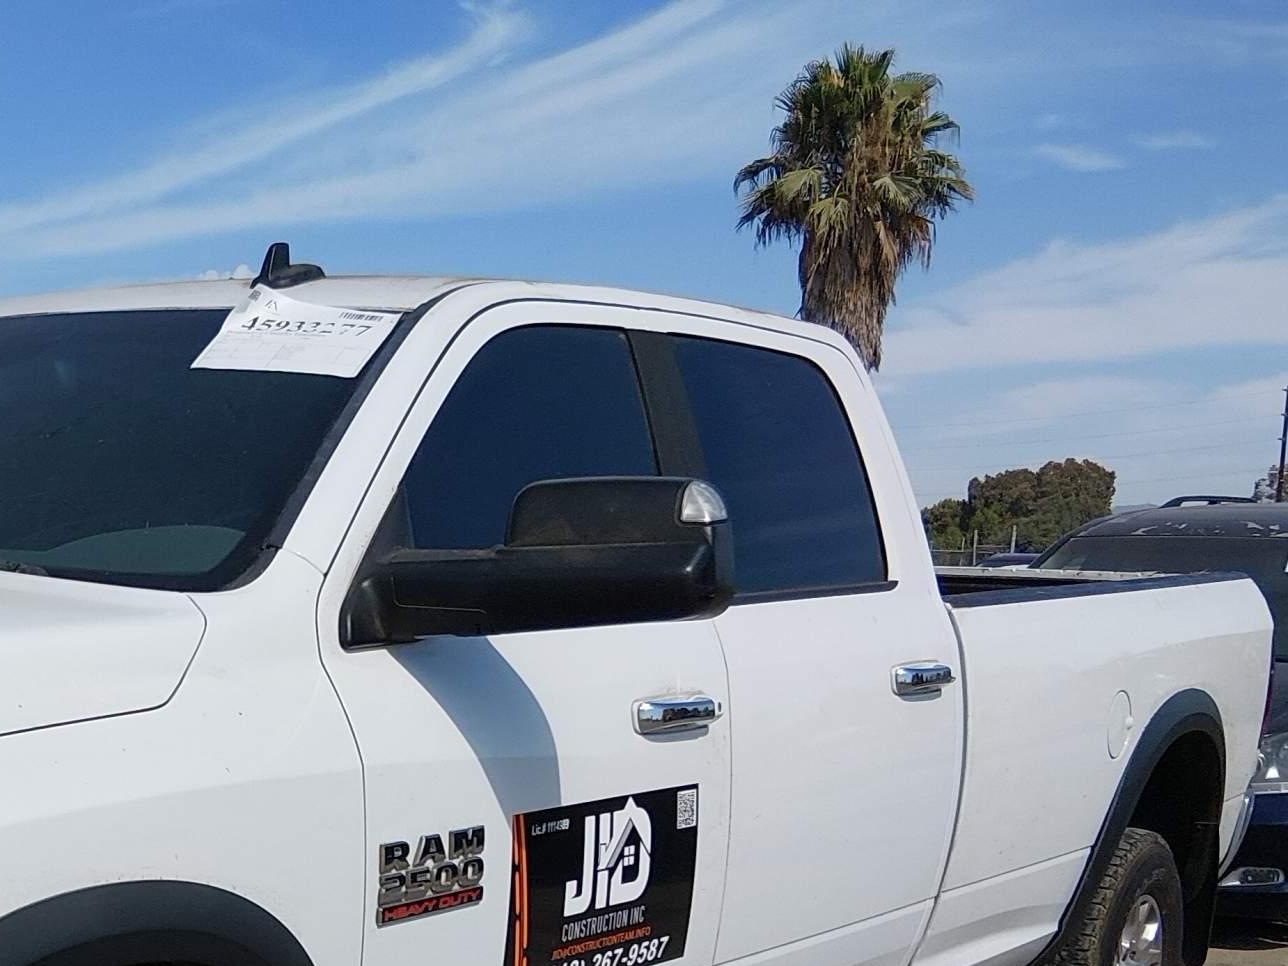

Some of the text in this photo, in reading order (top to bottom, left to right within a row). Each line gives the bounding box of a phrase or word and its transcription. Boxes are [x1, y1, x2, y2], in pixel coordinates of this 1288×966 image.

[378, 825, 485, 875] RAM
[378, 856, 485, 907] 2500
[382, 890, 481, 922] HEAVY DUTY
[561, 905, 646, 942] CONSTRUCTION INC
